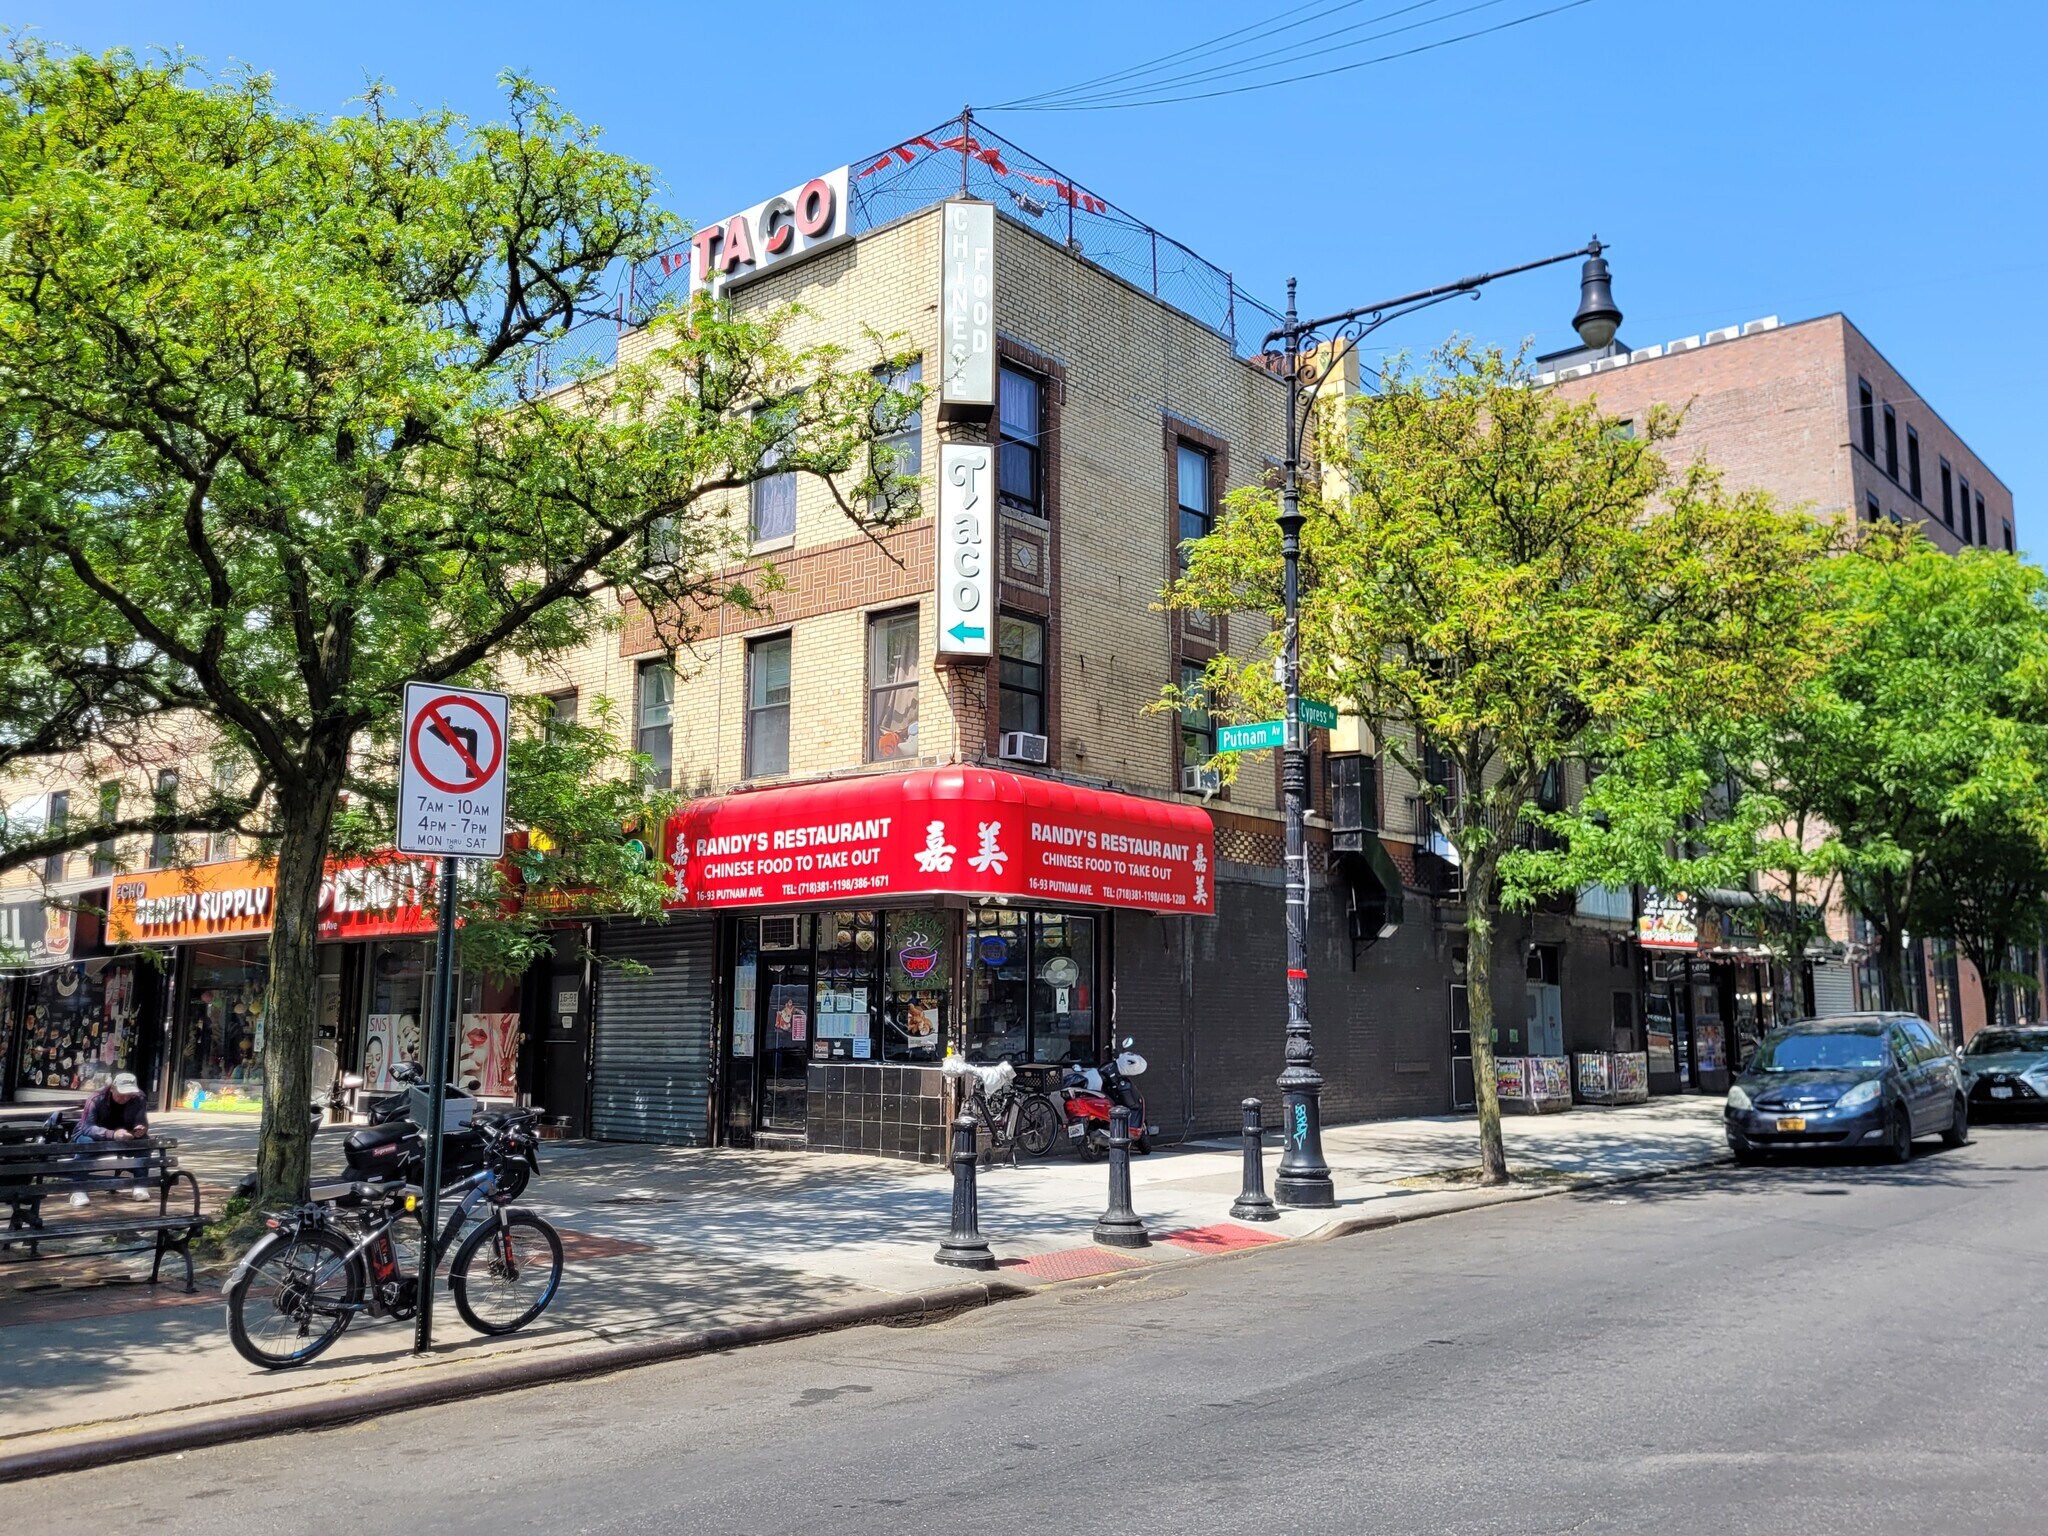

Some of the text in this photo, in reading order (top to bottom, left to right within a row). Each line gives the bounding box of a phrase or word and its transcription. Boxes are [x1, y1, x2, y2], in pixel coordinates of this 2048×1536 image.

[692, 178, 836, 281] TACO
[951, 206, 968, 396] CHINESE
[972, 247, 988, 353] FOOD
[947, 456, 987, 612] Taco
[1300, 702, 1335, 724] Cypress Av
[1223, 725, 1281, 748] Putnam Av
[417, 796, 443, 813] 7AM
[458, 799, 489, 816] 10AM
[417, 815, 446, 832] 4PM
[460, 818, 487, 835] 7PM
[417, 834, 442, 846] MON
[466, 837, 487, 849] SAT
[696, 817, 892, 857] RANDY'S RESTAURANT
[1031, 822, 1189, 862] RANDY'S RESTAURANT
[704, 847, 880, 879] CHINESE FOOD TO TAKE OUT
[1042, 851, 1172, 881] CHINESE FOOD TO TAKE OUT
[116, 881, 146, 900] ECHO
[696, 890, 715, 901] 16-93
[716, 887, 747, 900] PUTNAM
[782, 884, 797, 895] TEL:
[1029, 877, 1048, 891] 16-93
[1049, 879, 1078, 894] PUTNAM
[1103, 886, 1115, 898] TEL:
[135, 886, 269, 926] BEAUTY SUPPLY
[906, 959, 931, 970] OPEN
[823, 992, 832, 1006] A
[1059, 991, 1067, 1005] A
[369, 1017, 387, 1032] SNS
